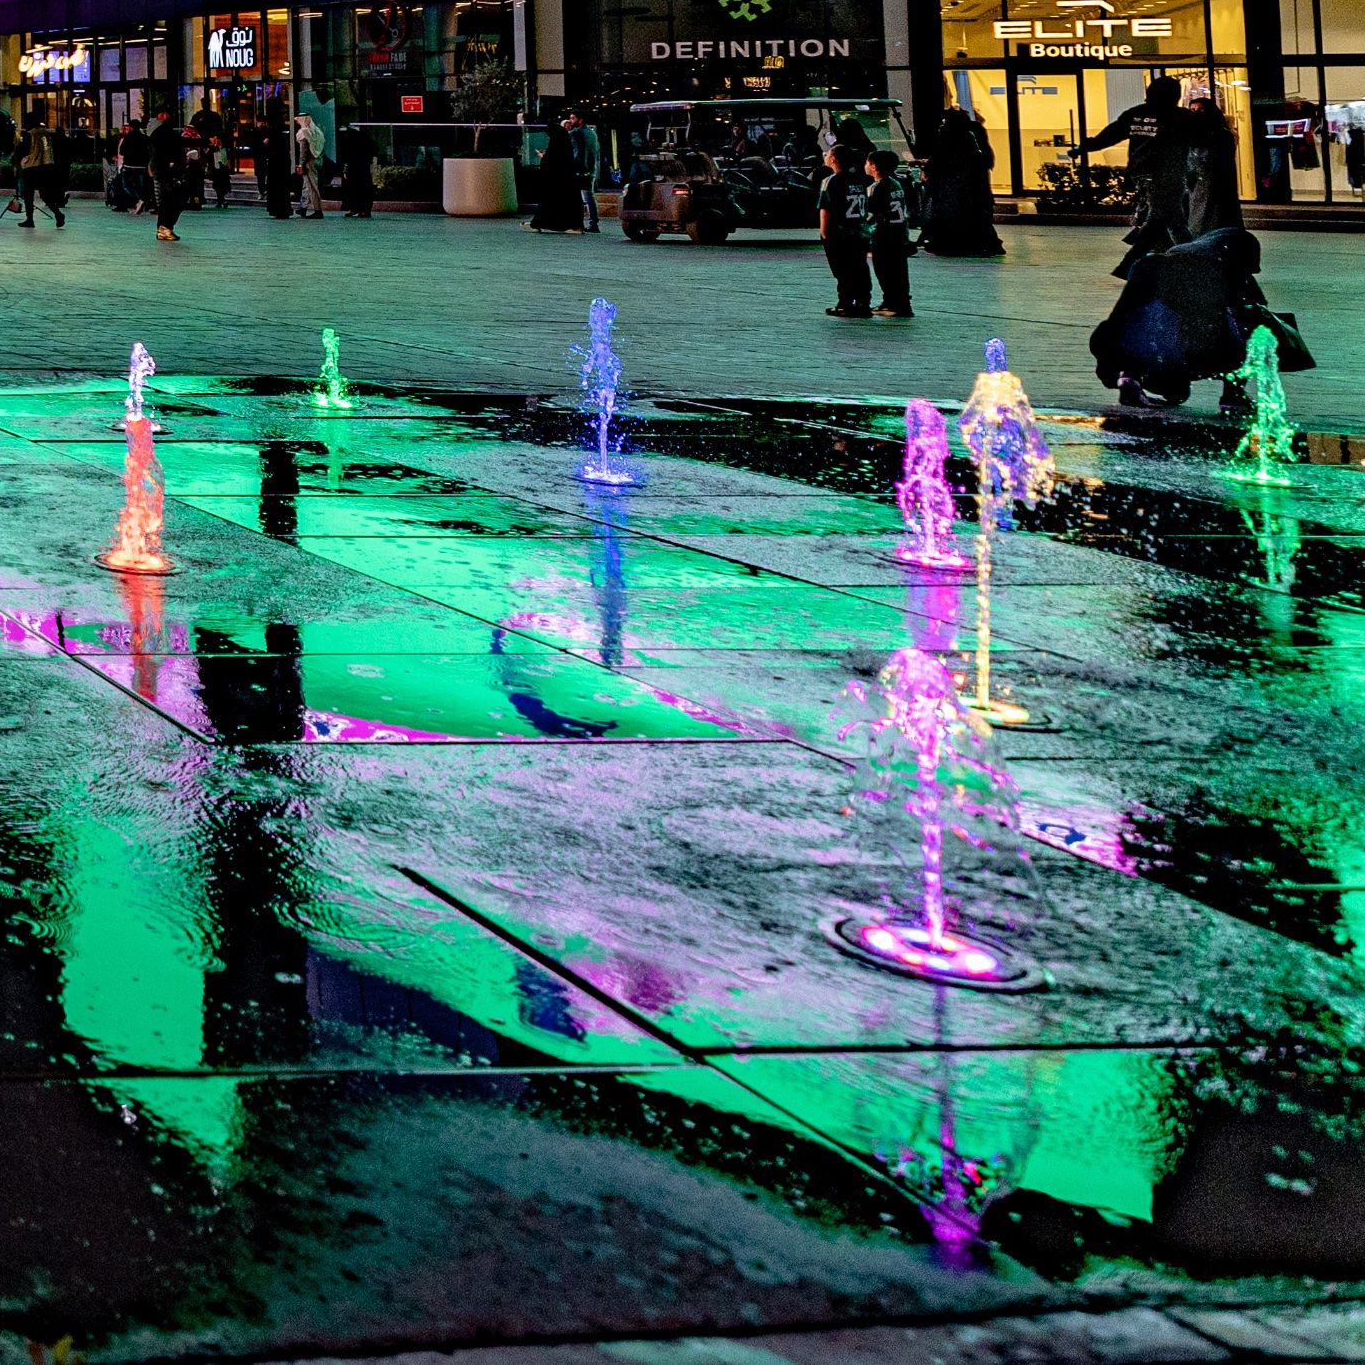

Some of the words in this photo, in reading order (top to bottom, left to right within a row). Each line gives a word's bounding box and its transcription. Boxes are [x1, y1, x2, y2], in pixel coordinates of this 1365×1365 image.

[993, 18, 1173, 39] ELITE
[225, 48, 254, 68] NOUG
[651, 39, 850, 59] DEFINITION
[1030, 41, 1133, 60] Boutique
[990, 86, 1058, 95] EITE
